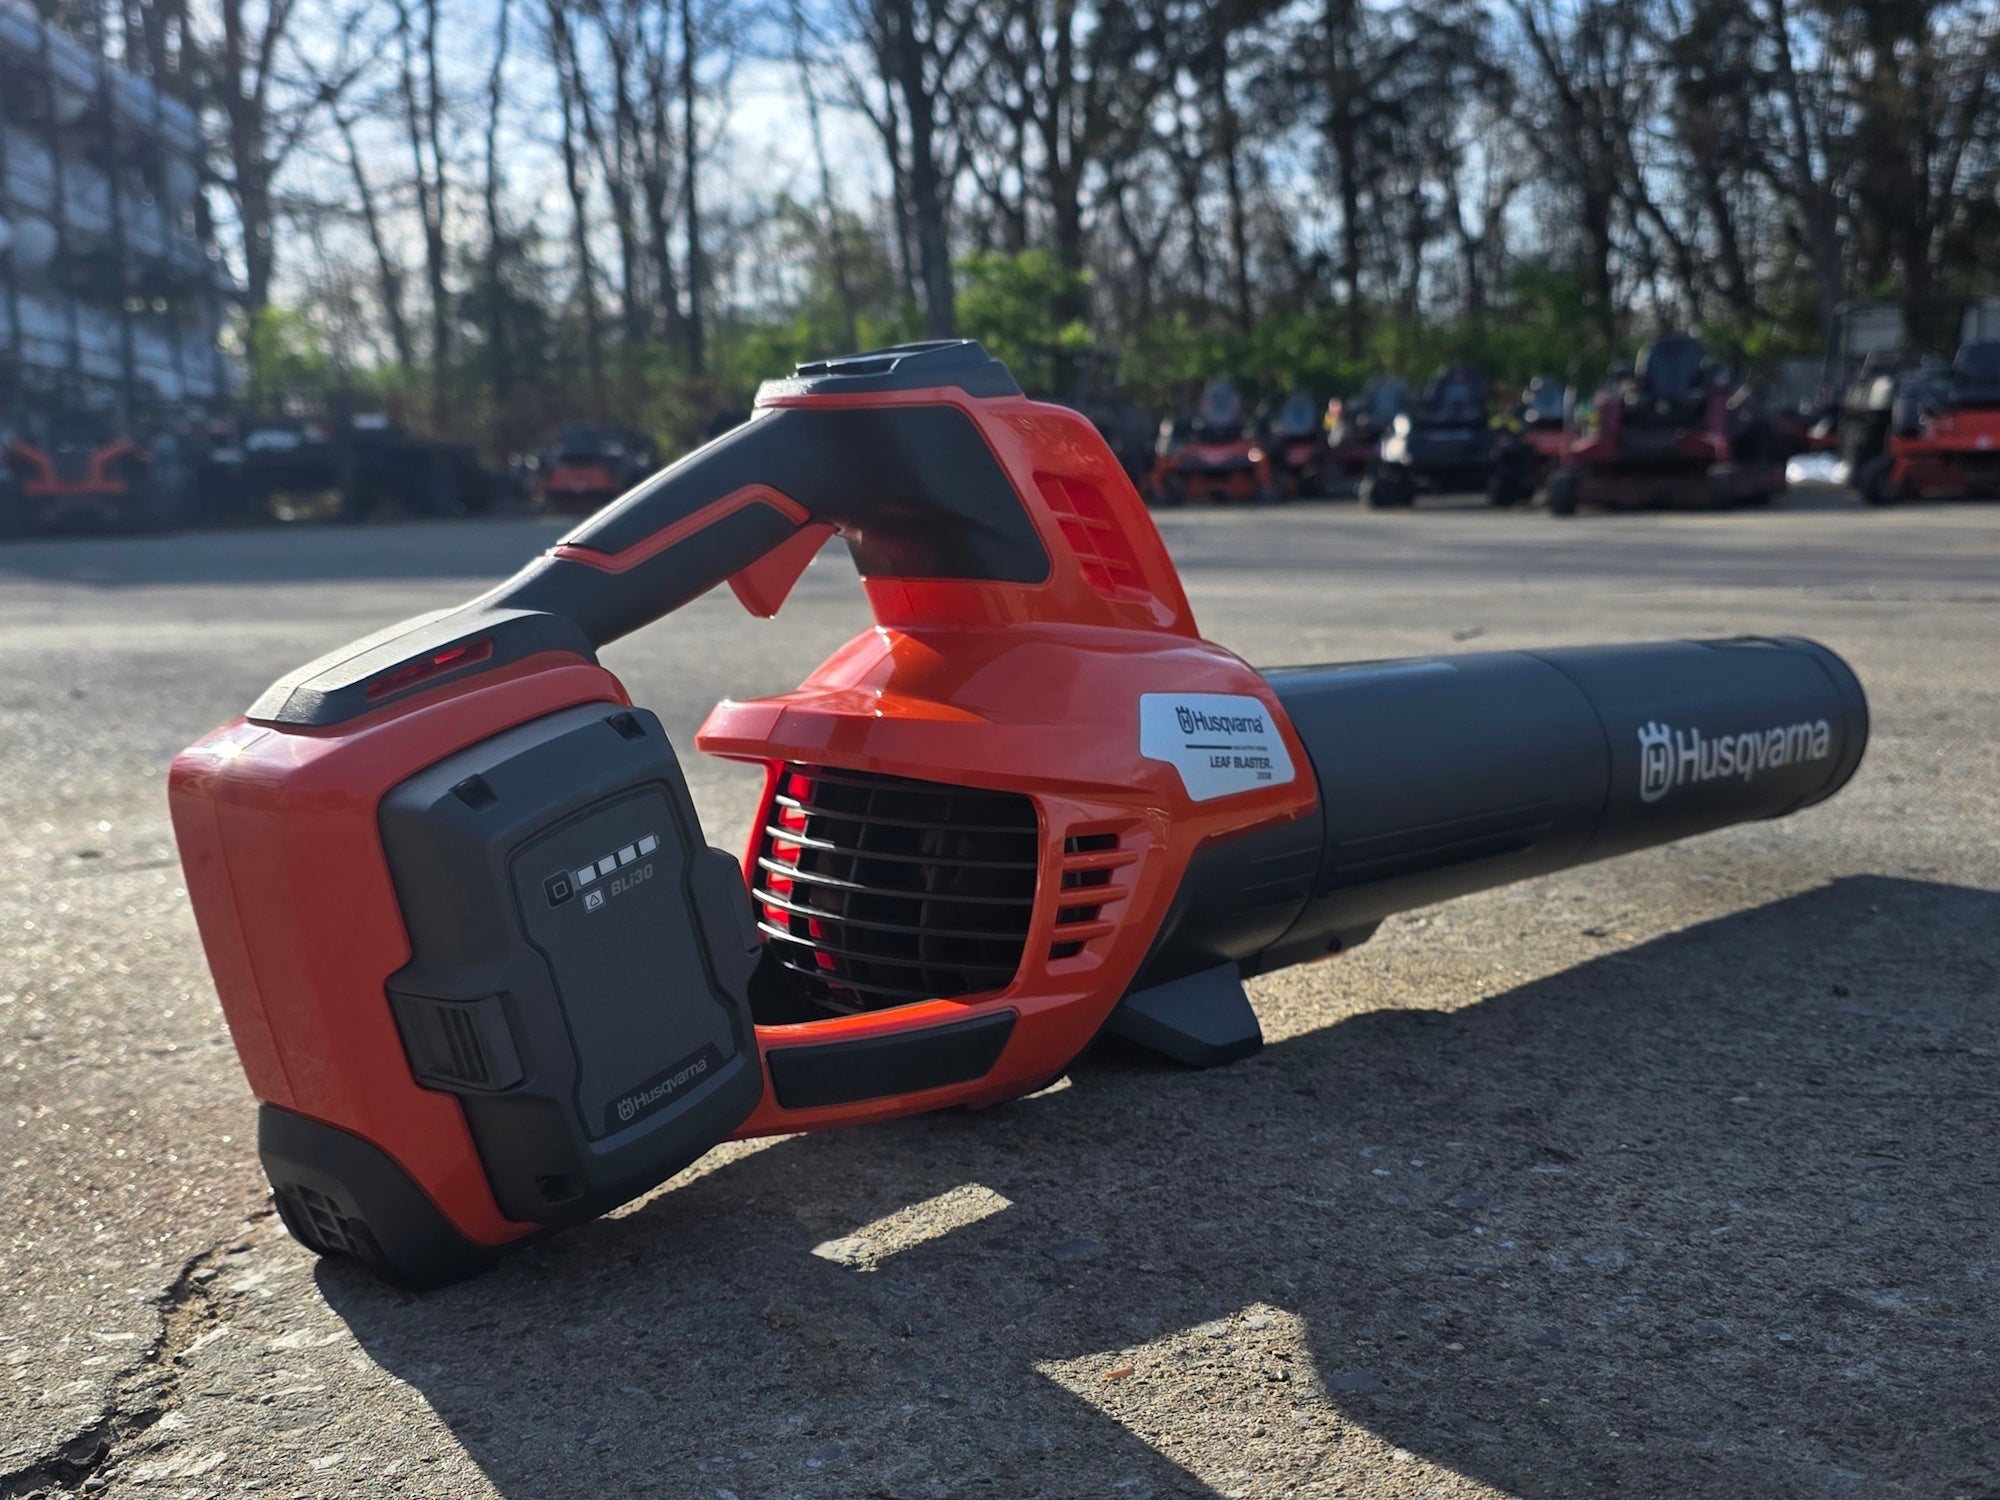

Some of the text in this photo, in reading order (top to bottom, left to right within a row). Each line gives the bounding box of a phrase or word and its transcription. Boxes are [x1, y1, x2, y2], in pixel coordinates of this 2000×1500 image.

[1193, 711, 1264, 735] Husqvarna
[1210, 755, 1232, 768] LEAF
[1675, 718, 1830, 783] Husqvarna
[611, 863, 653, 897] BLi30
[633, 1058, 708, 1110] Husqvarna
